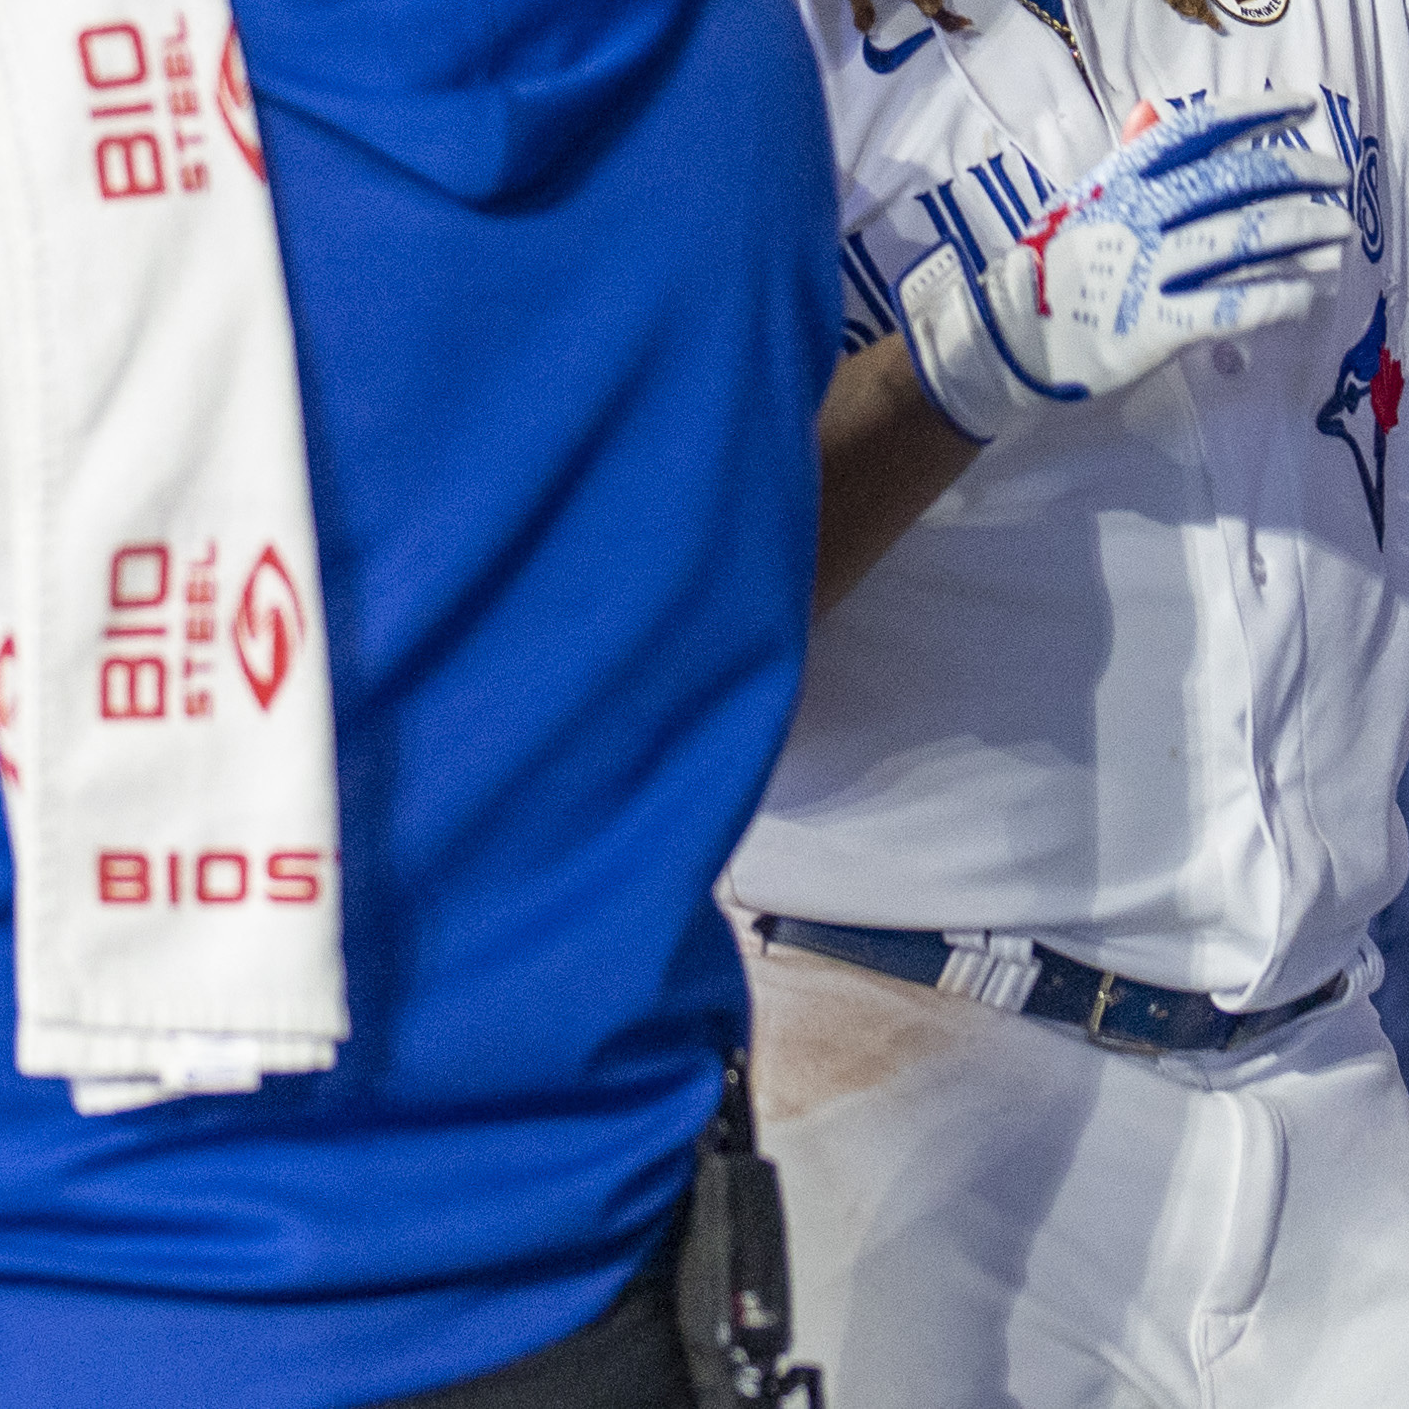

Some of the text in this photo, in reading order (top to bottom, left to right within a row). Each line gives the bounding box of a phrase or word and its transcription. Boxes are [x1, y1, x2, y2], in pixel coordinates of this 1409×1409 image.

[78, 23, 166, 199] BIO
[163, 11, 210, 193] STEEL
[100, 542, 168, 720] BIO
[184, 538, 216, 719] STEEL
